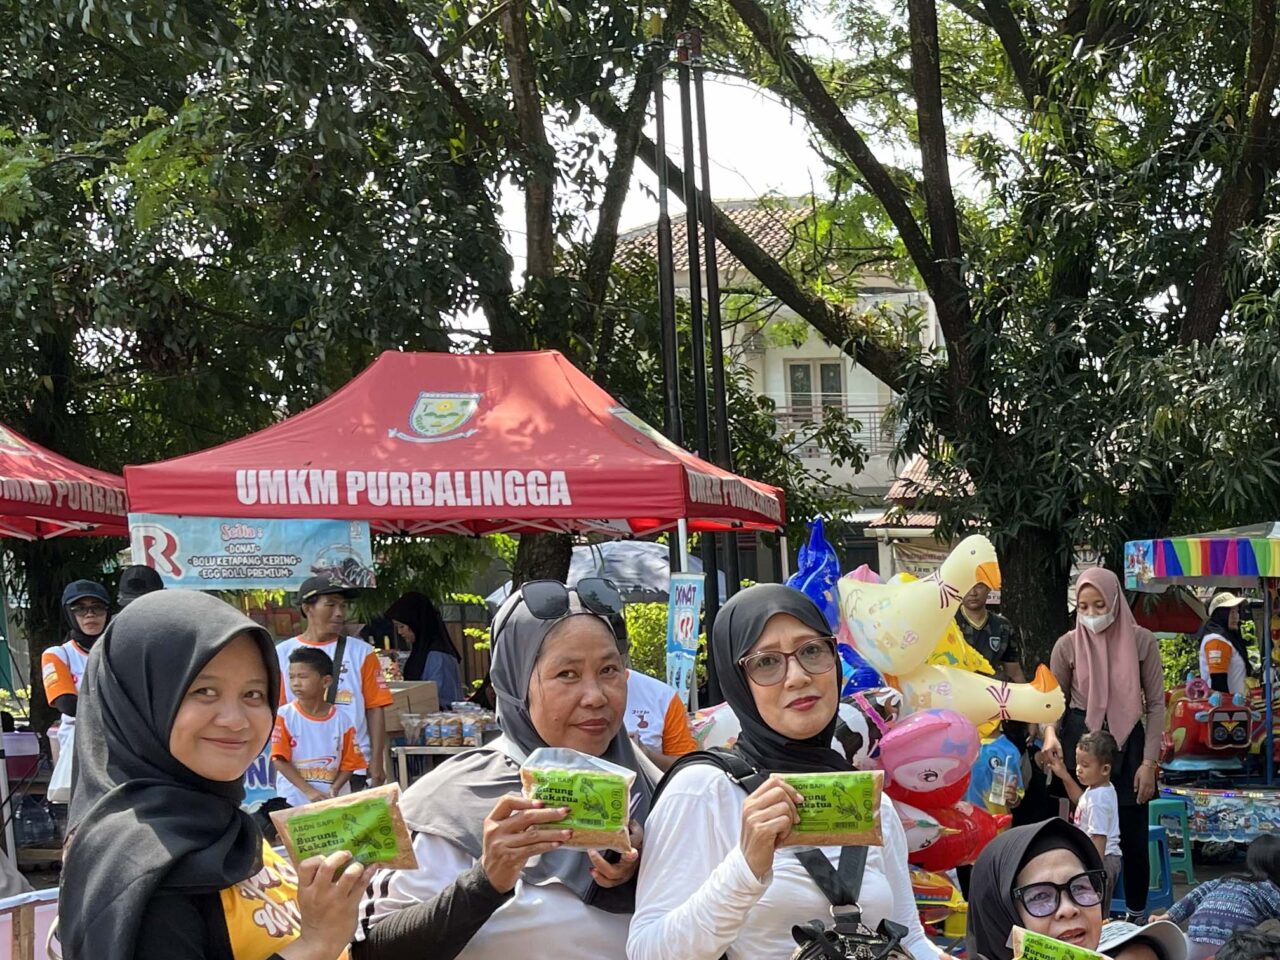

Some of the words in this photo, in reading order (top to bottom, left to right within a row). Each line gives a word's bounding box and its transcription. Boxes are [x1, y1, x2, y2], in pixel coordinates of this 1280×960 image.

[0, 477, 53, 506] MKM
[236, 469, 339, 507] UMKM
[345, 470, 573, 508] PURBALINGGA
[220, 523, 256, 541] Sedia
[216, 555, 261, 567] KETAPANG
[222, 568, 247, 579] ROLL
[296, 830, 338, 846] Burung
[298, 837, 345, 854] Kakatua
